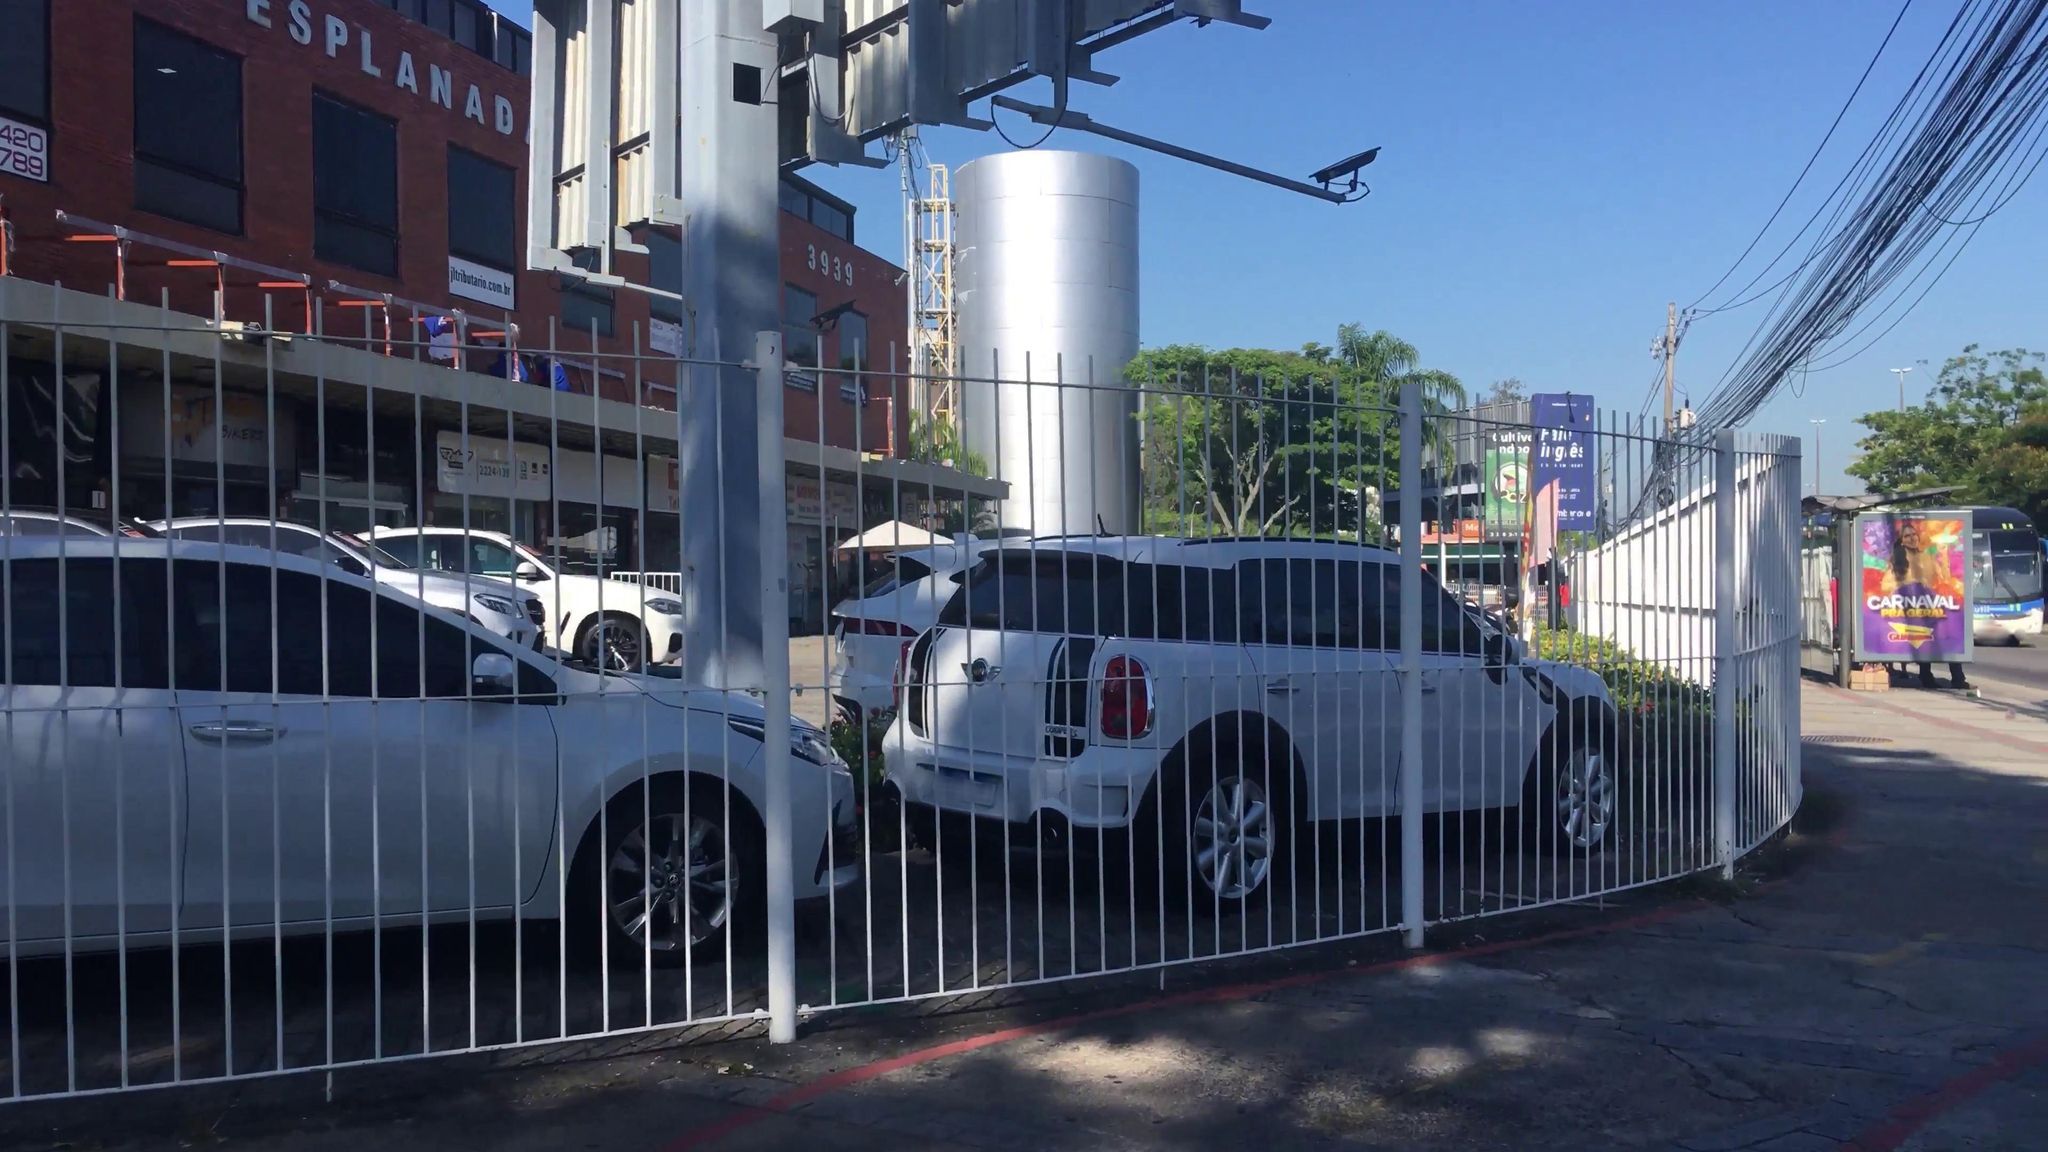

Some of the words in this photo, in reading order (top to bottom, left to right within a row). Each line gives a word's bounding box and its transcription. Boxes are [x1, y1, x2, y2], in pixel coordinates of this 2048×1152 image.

[246, 0, 531, 145] ESPLANAD
[0, 124, 43, 153] 420
[807, 243, 853, 287] 3939
[1867, 594, 1960, 610] CARNAVAL
